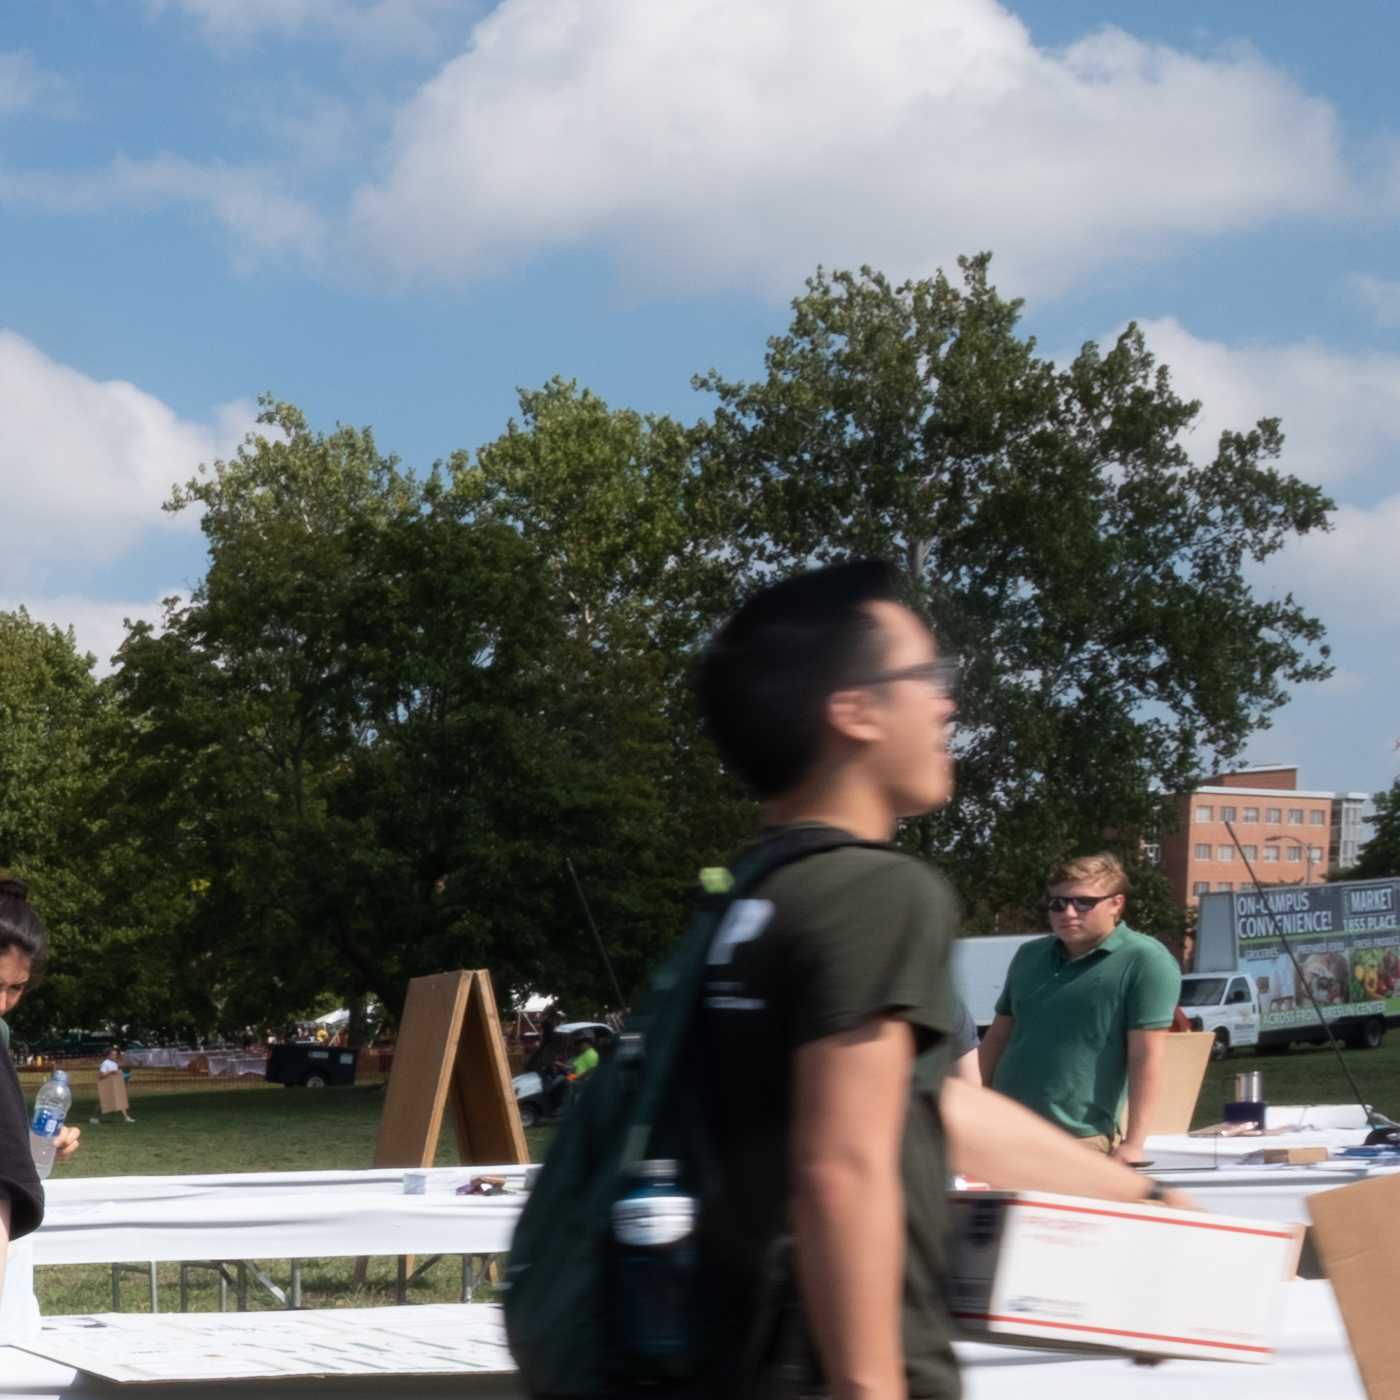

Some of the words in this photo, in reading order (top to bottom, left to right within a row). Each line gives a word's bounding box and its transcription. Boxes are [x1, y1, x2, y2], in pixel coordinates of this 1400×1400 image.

[1237, 891, 1310, 916] ON-CAMPUS
[1350, 888, 1393, 913] MARKET
[1238, 911, 1333, 939] CONVENIENCE!
[1343, 918, 1365, 933] 1855
[1366, 914, 1397, 930] PLACE
